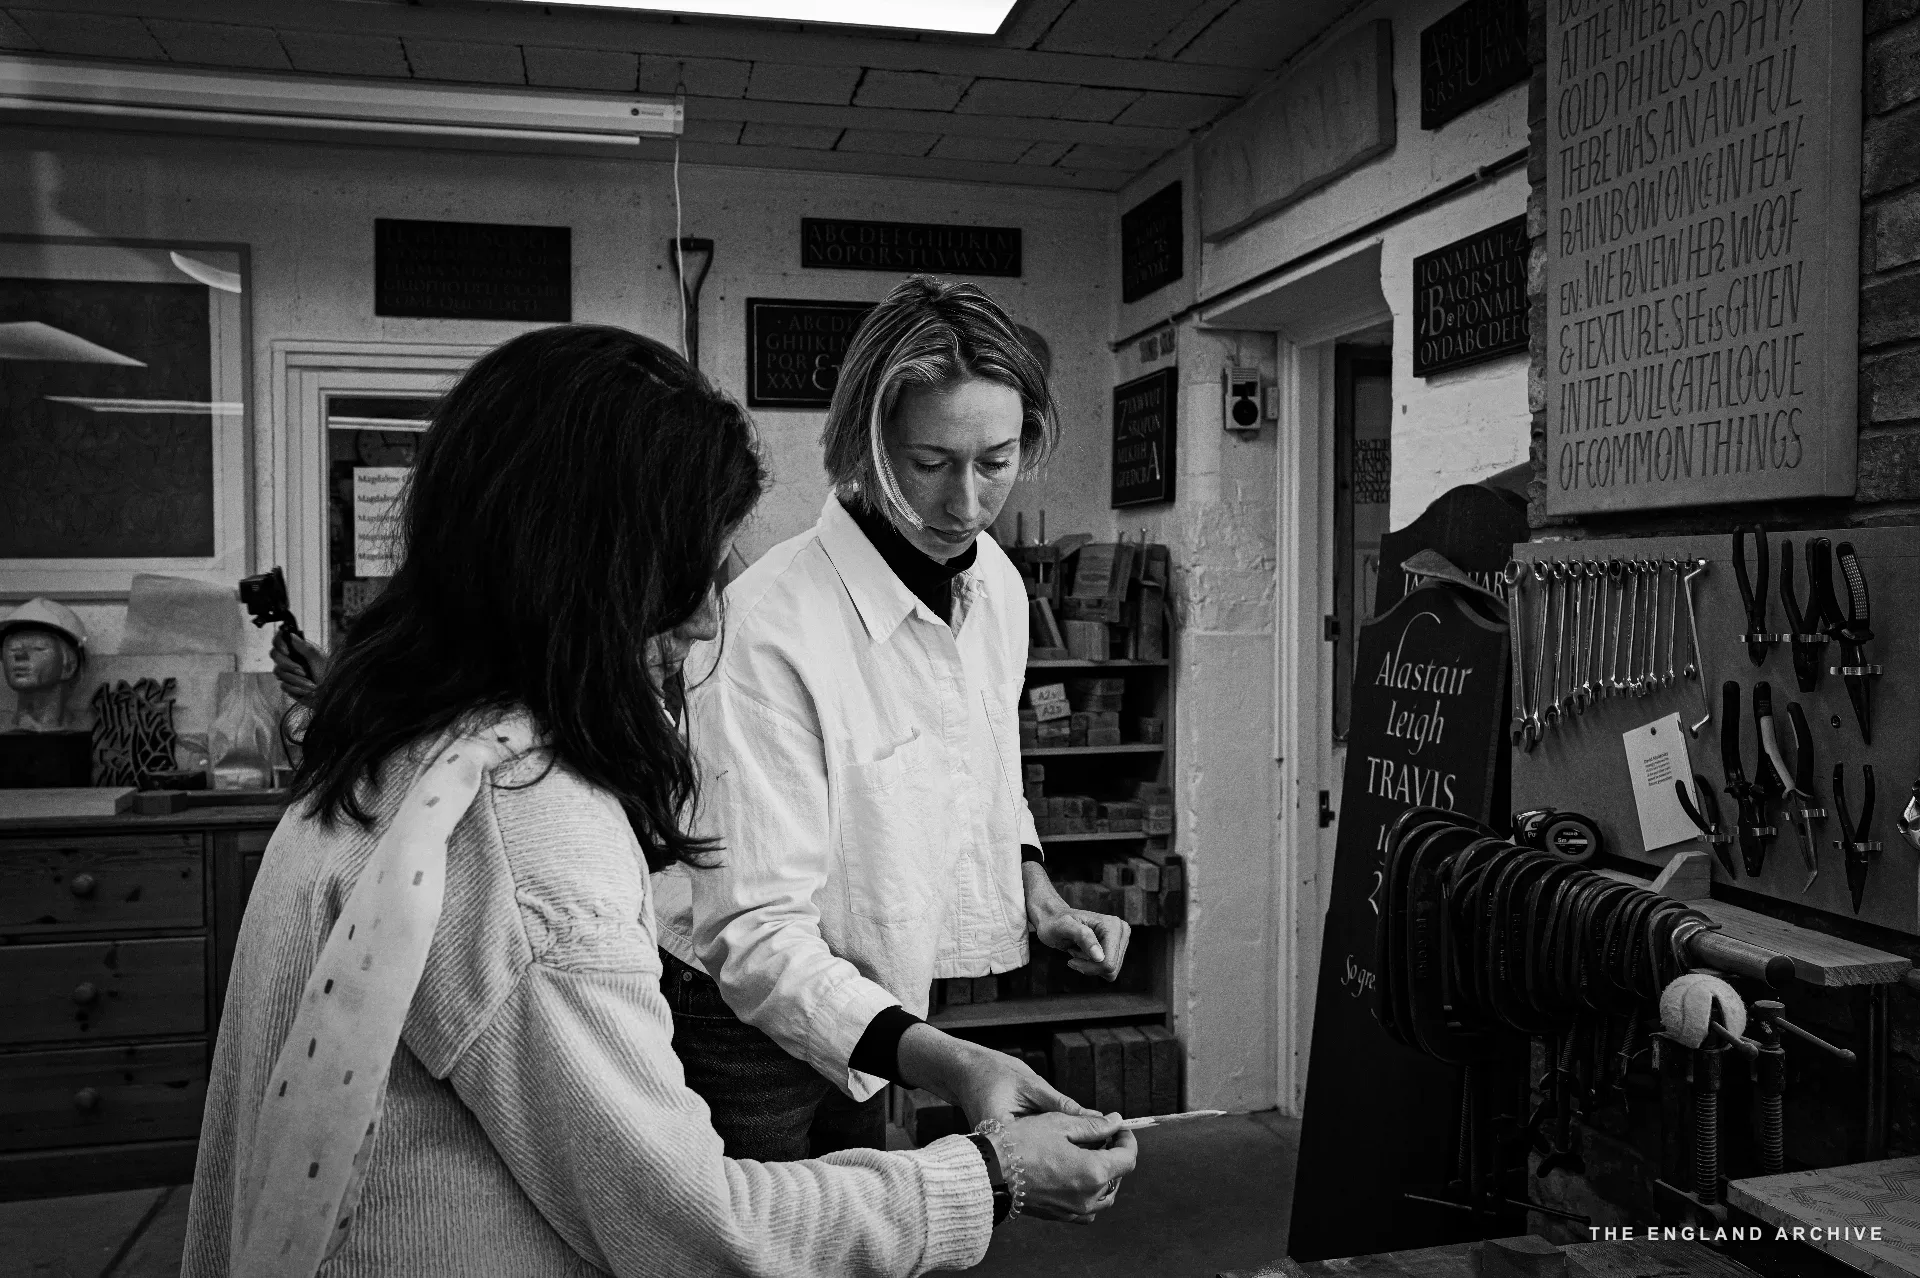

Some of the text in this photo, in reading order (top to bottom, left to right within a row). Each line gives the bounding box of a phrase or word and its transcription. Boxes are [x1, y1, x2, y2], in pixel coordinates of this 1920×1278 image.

[1558, 71, 1609, 140] COLD
[1559, 44, 1802, 200] THERE WAS AN AWFUL
[1560, 166, 1663, 258] RAINBOW
[1665, 153, 1713, 222] ONCE
[1716, 138, 1746, 205] IN
[1585, 248, 1616, 308] WE
[1687, 216, 1726, 283] HER
[1730, 188, 1802, 269] WOOF
[1559, 325, 1574, 376] &
[1671, 287, 1708, 351] SHE
[1726, 260, 1804, 338] GIVEN
[1560, 332, 1805, 435] IN THE DULL CATALOGUE
[1559, 407, 1804, 492] OF COMMON THINGS
[1374, 611, 1474, 696] Alastair
[1386, 700, 1445, 755] Leigh
[1367, 757, 1455, 811] TRAVIS
